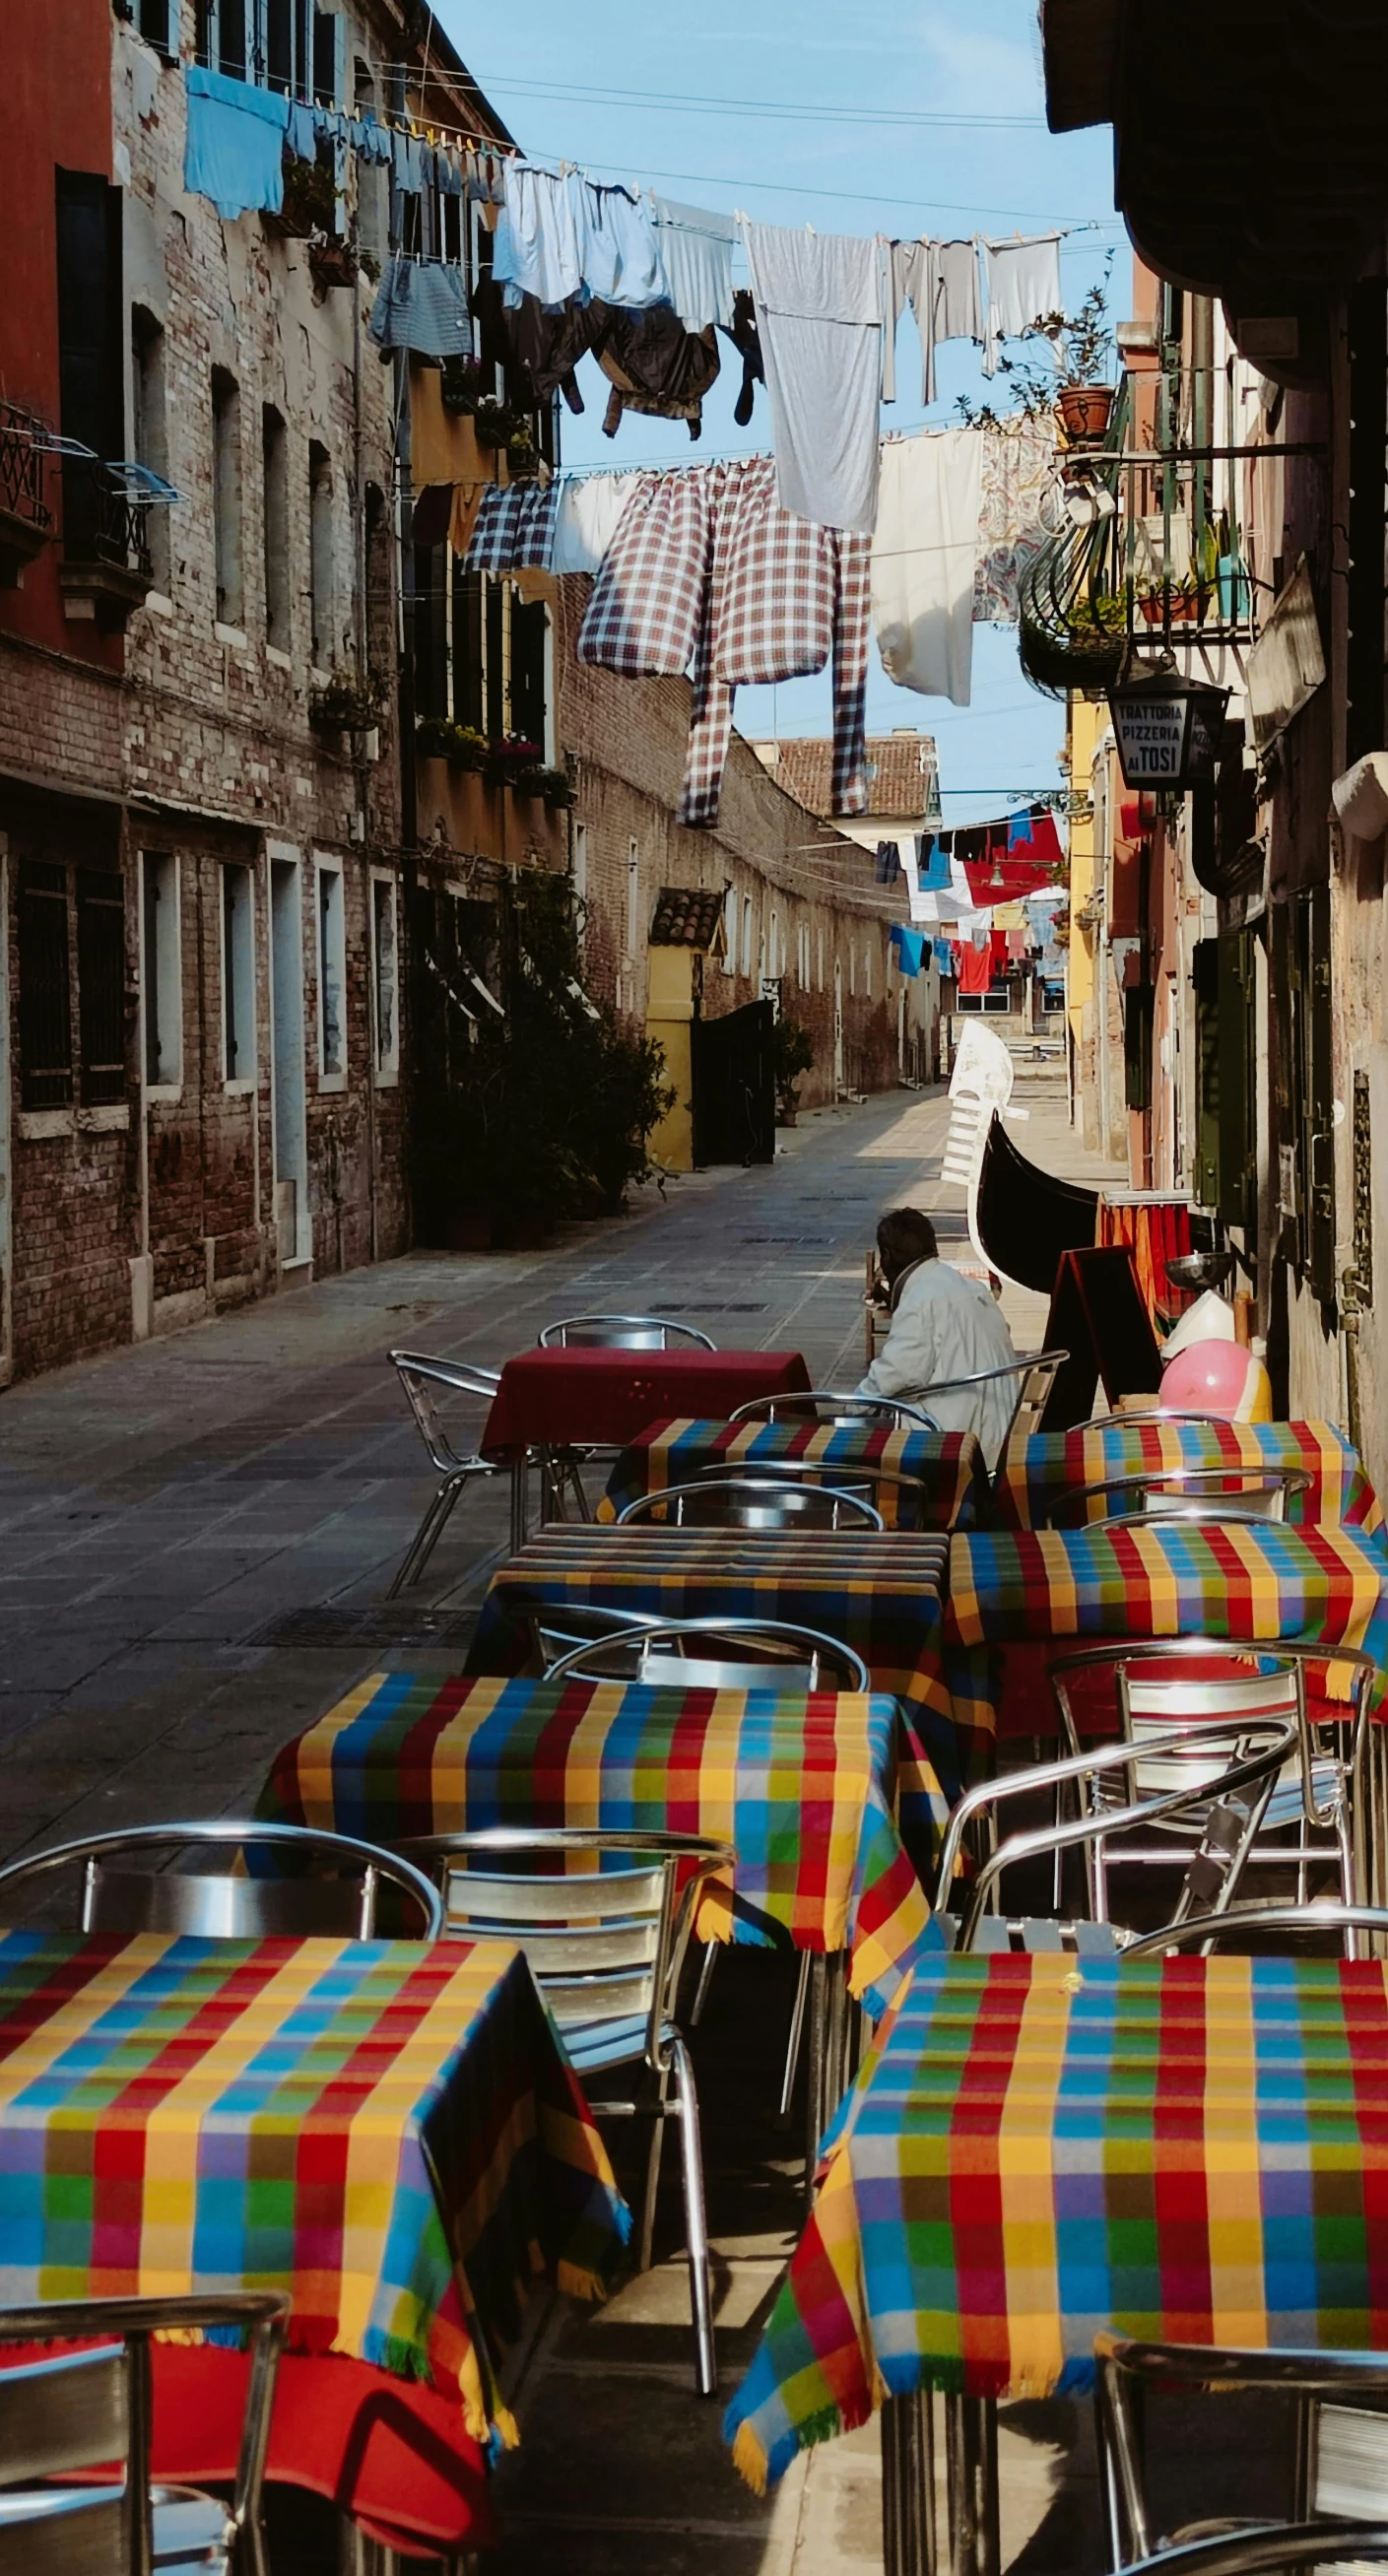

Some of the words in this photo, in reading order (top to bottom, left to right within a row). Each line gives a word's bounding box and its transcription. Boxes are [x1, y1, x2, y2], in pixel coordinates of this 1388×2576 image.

[1119, 705, 1182, 720] TRATTORIA
[1122, 725, 1180, 741] PIZZERIA
[1139, 747, 1176, 772] TOSI
